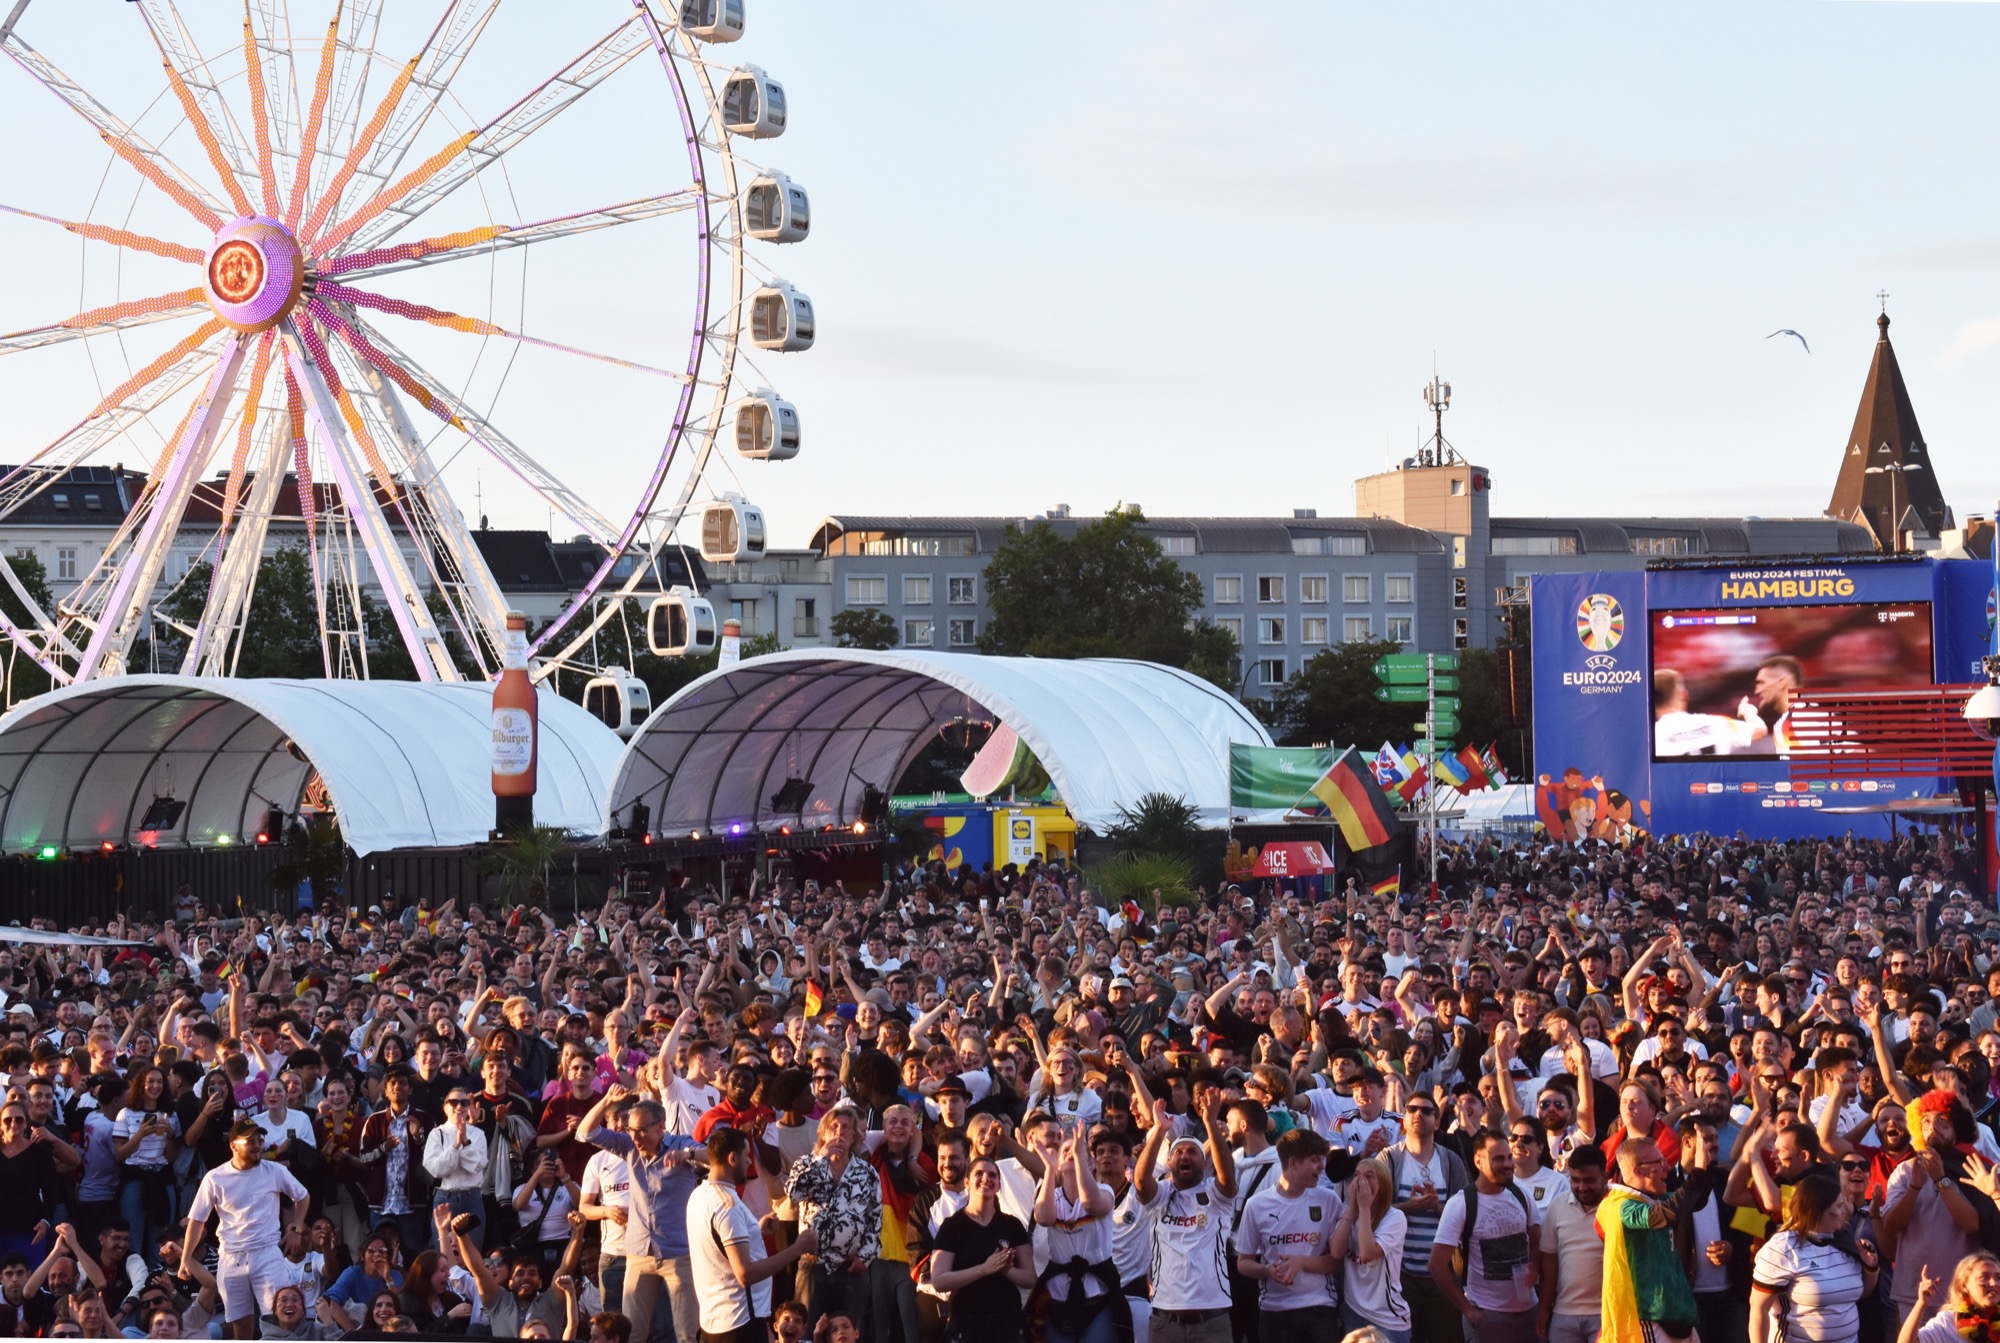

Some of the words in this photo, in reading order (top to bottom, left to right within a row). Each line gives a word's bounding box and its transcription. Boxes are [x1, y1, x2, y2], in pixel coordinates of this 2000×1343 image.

[1730, 571, 1760, 579] EURO
[1763, 570, 1791, 578] 2024
[1794, 568, 1845, 577] FESTIVAL
[1722, 578, 1854, 599] HAMBURG
[1586, 657, 1615, 669] UEFA
[1563, 670, 1641, 685] EURO2024
[1580, 686, 1623, 694] GERMANY
[492, 729, 529, 745] Bitburger
[1270, 850, 1287, 867] ICE
[1270, 867, 1287, 875] CREAM
[604, 1182, 630, 1194] CHEC
[1269, 1231, 1321, 1247] CHECK24
